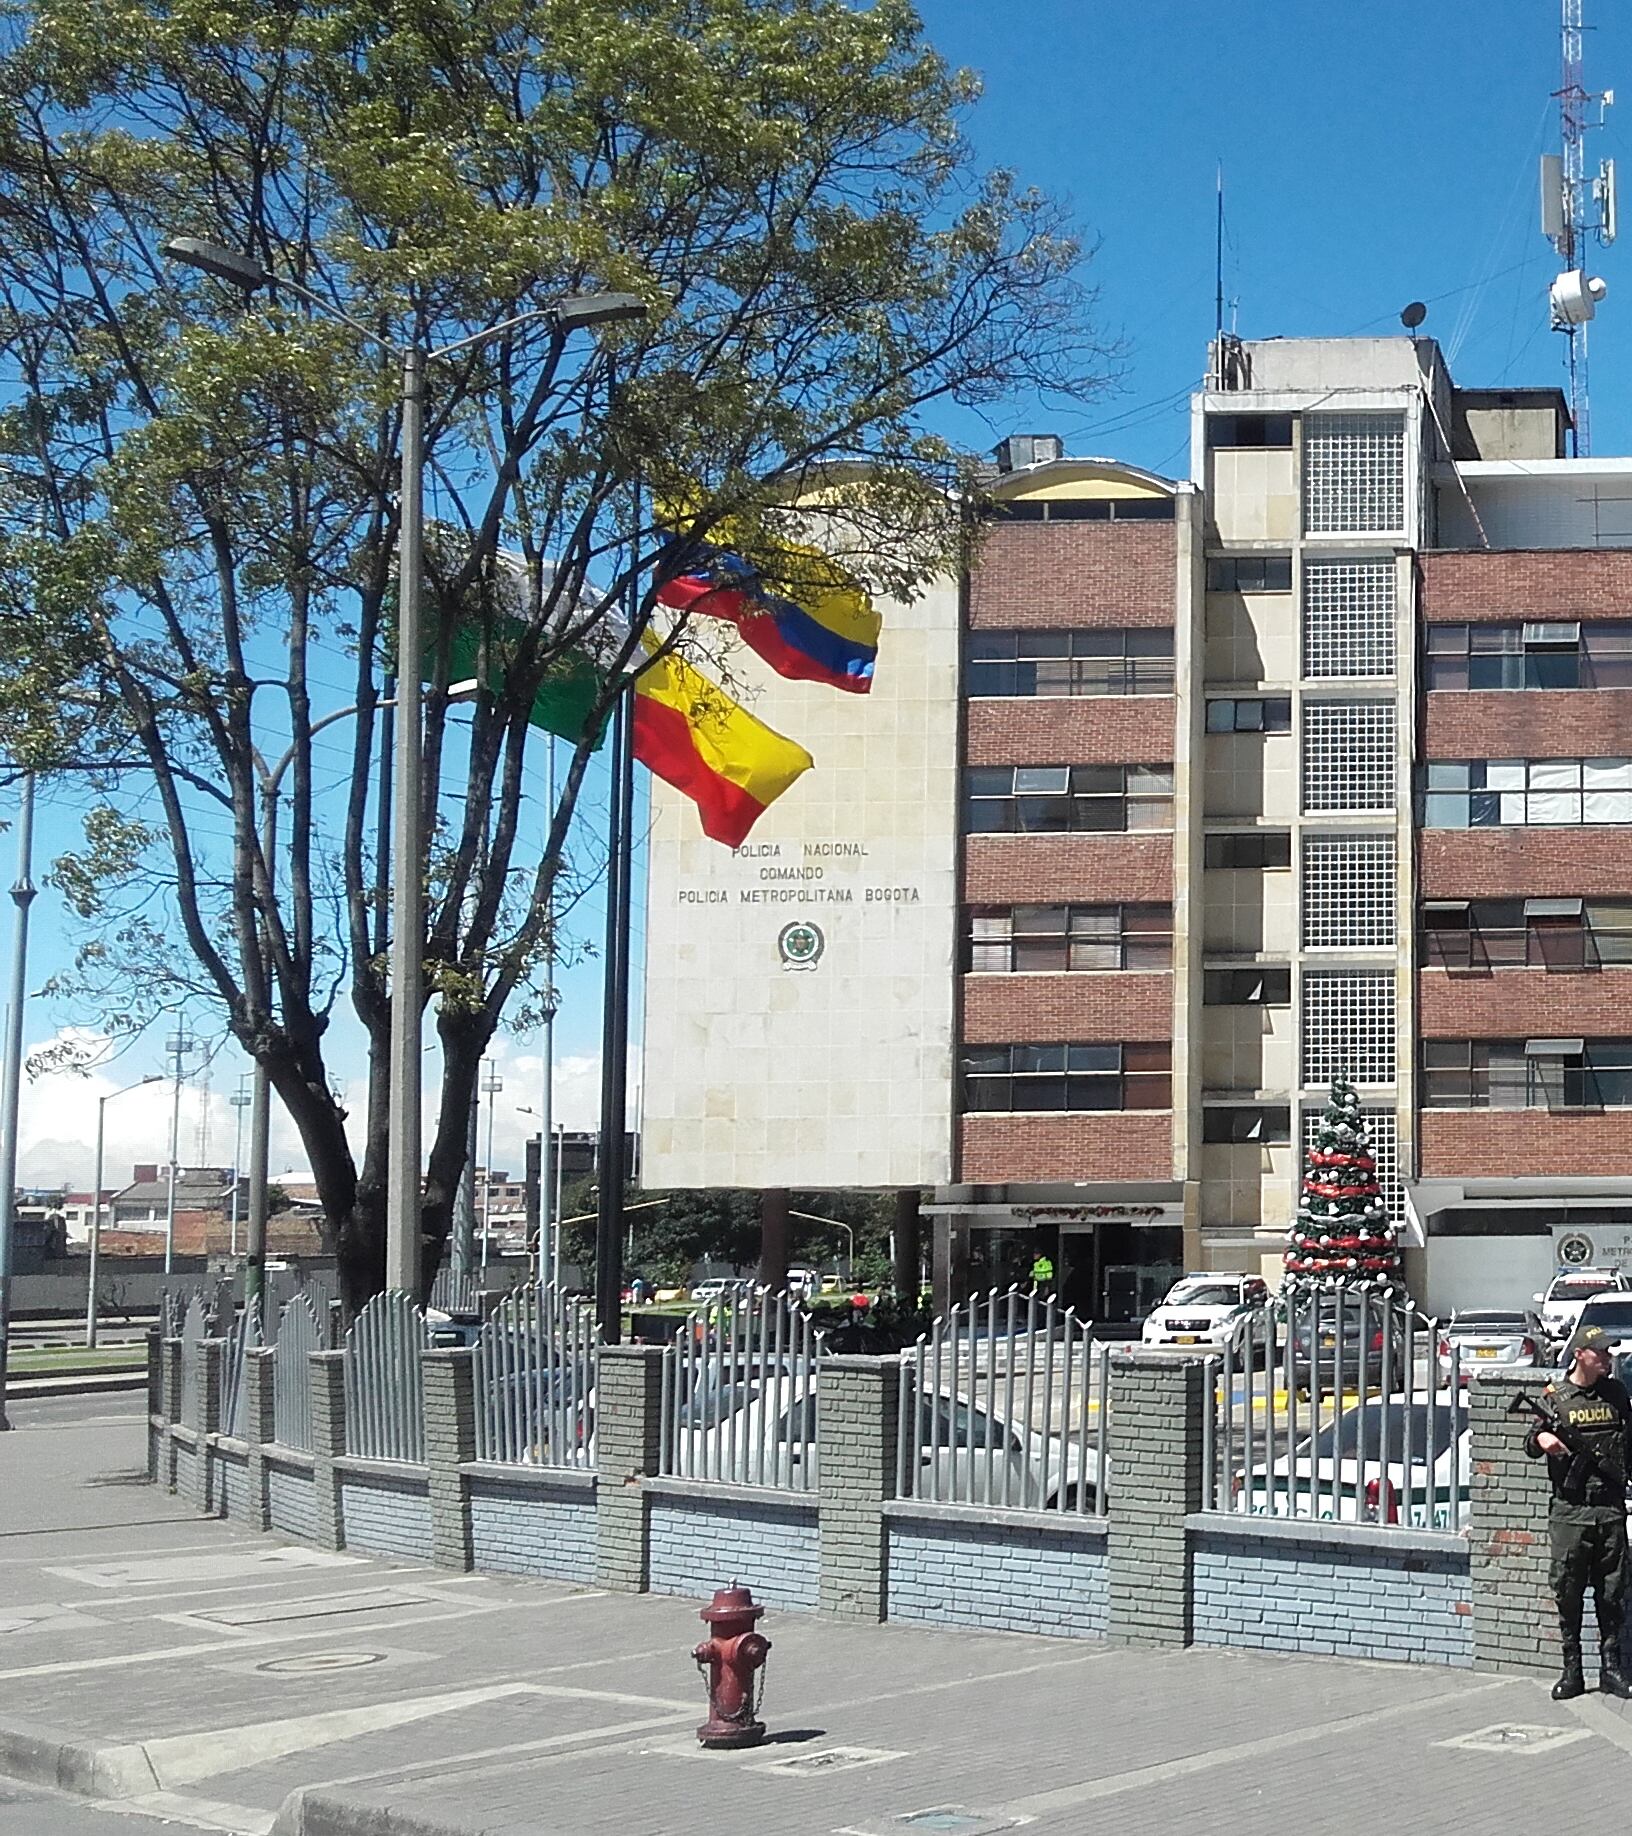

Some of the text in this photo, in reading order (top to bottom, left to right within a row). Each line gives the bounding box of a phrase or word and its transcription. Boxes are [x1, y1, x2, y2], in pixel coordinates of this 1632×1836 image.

[732, 843, 869, 857] POLICIA NACIONAL
[760, 866, 823, 880] COMANDO
[679, 887, 919, 903] POLICIA METROPOLITANA BOGOTA
[1569, 1408, 1612, 1423] POLICIA
